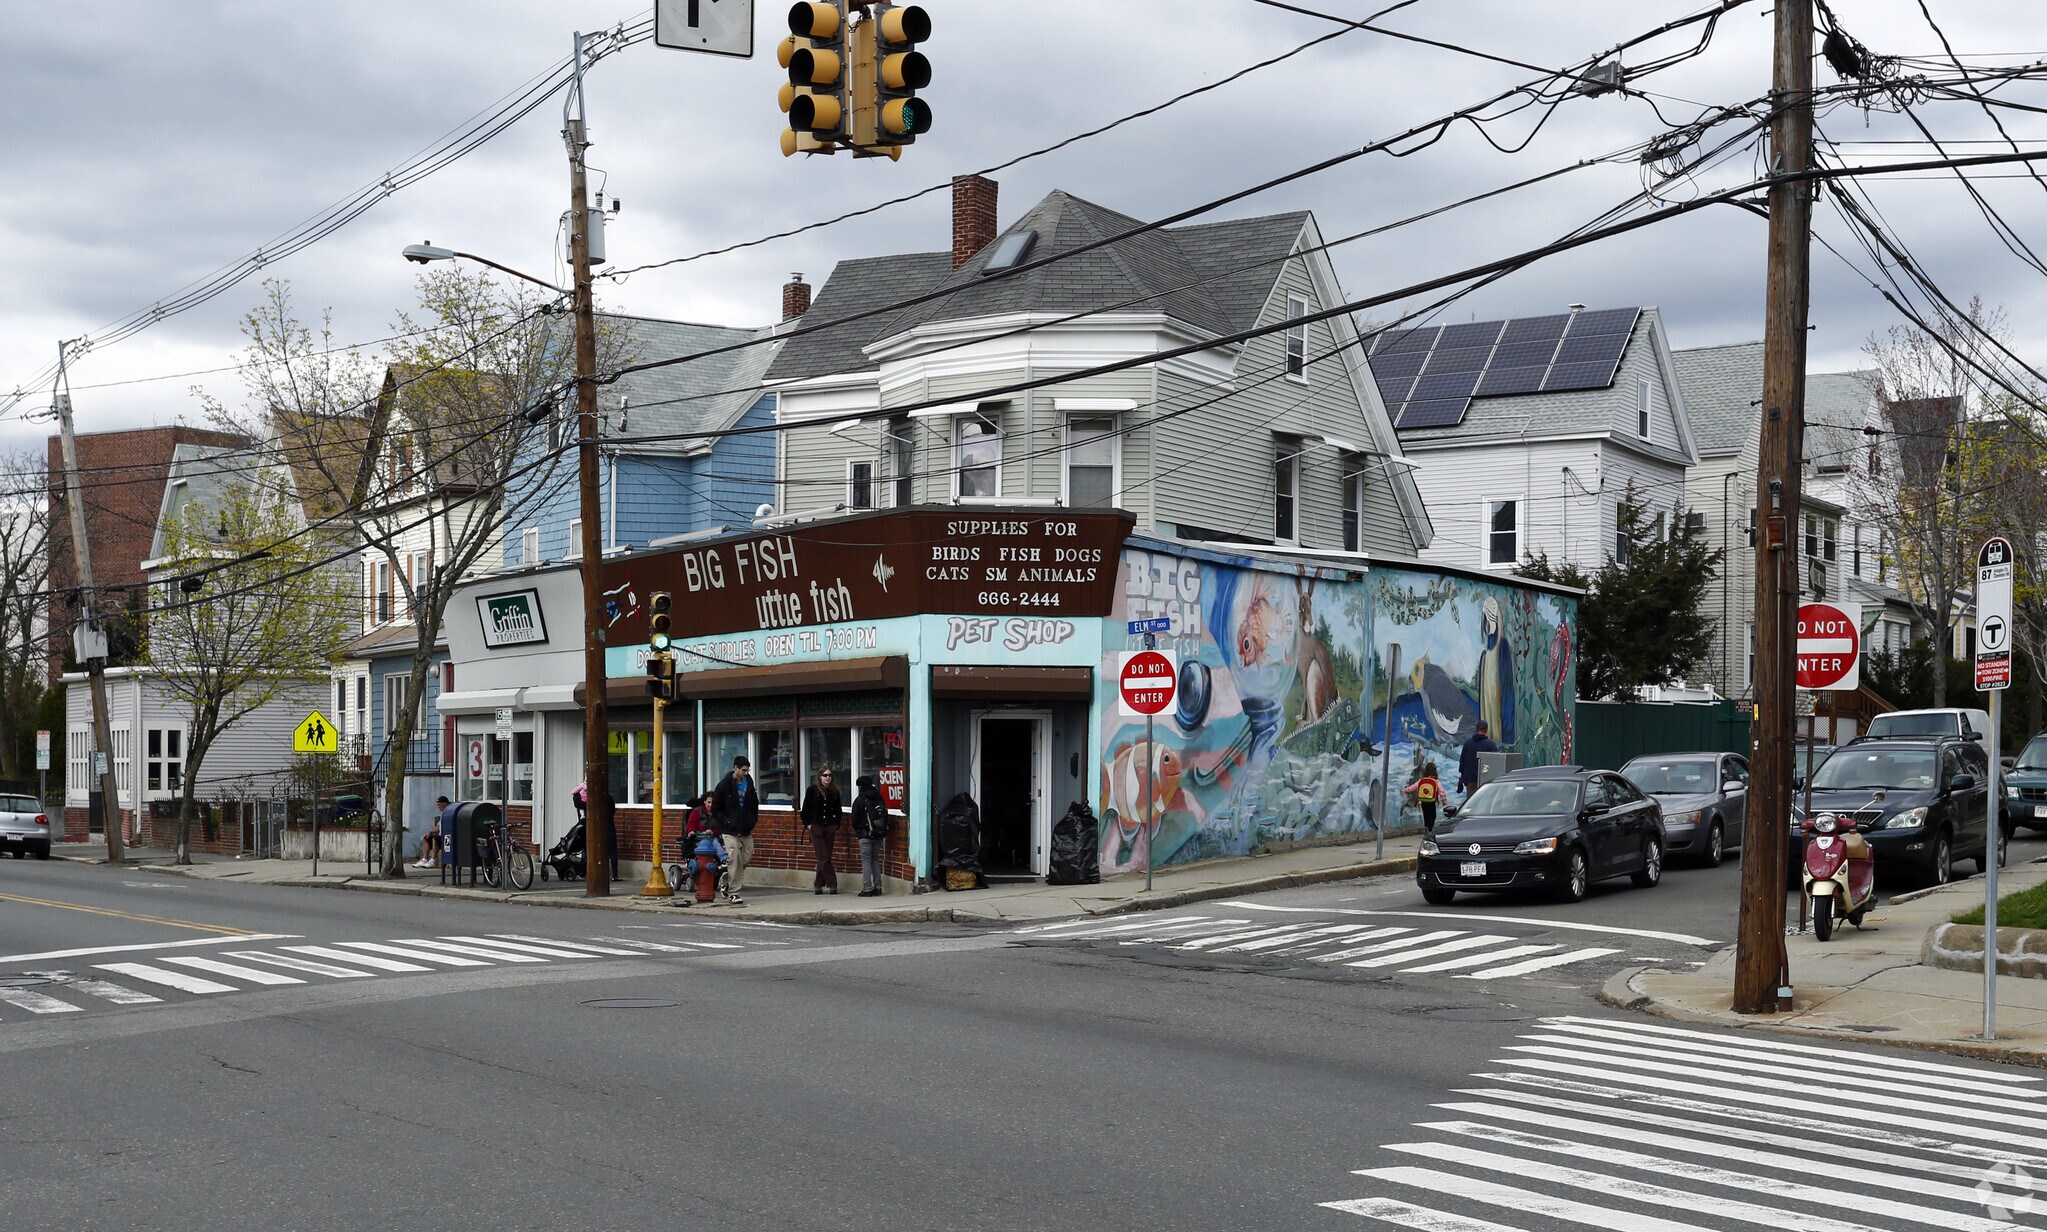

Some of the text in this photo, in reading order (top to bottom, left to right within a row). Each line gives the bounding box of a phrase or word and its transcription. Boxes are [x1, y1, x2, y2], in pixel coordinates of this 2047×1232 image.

[947, 521, 1077, 536] SUPPLIES FOR
[932, 546, 1101, 563] BIRDS FISH DOGS
[683, 535, 799, 592] BIG FISH
[926, 567, 1097, 583] CATS SM ANIMALS
[1125, 549, 1201, 603] BIG
[1981, 569, 1992, 580] 87
[809, 577, 855, 622] fish
[978, 592, 1060, 607] 666-2444
[490, 604, 532, 633] Griffin
[946, 617, 1075, 651] PET SHOP
[1134, 621, 1149, 632] ELM
[1797, 621, 1847, 634] O NOT
[1985, 623, 2002, 644] T
[495, 630, 535, 643] PROPERTIES
[683, 644, 708, 667] CAT
[708, 639, 756, 665] SUPPLIES
[765, 633, 795, 657] OPEN
[799, 630, 822, 652] TIL
[824, 627, 854, 655] 7:00
[856, 626, 877, 649] PM
[1131, 663, 1165, 674] DO NOT
[1797, 658, 1842, 671] NTER
[1134, 692, 1164, 703] ENTER
[470, 741, 483, 777] 3
[879, 770, 903, 785] SCIEN
